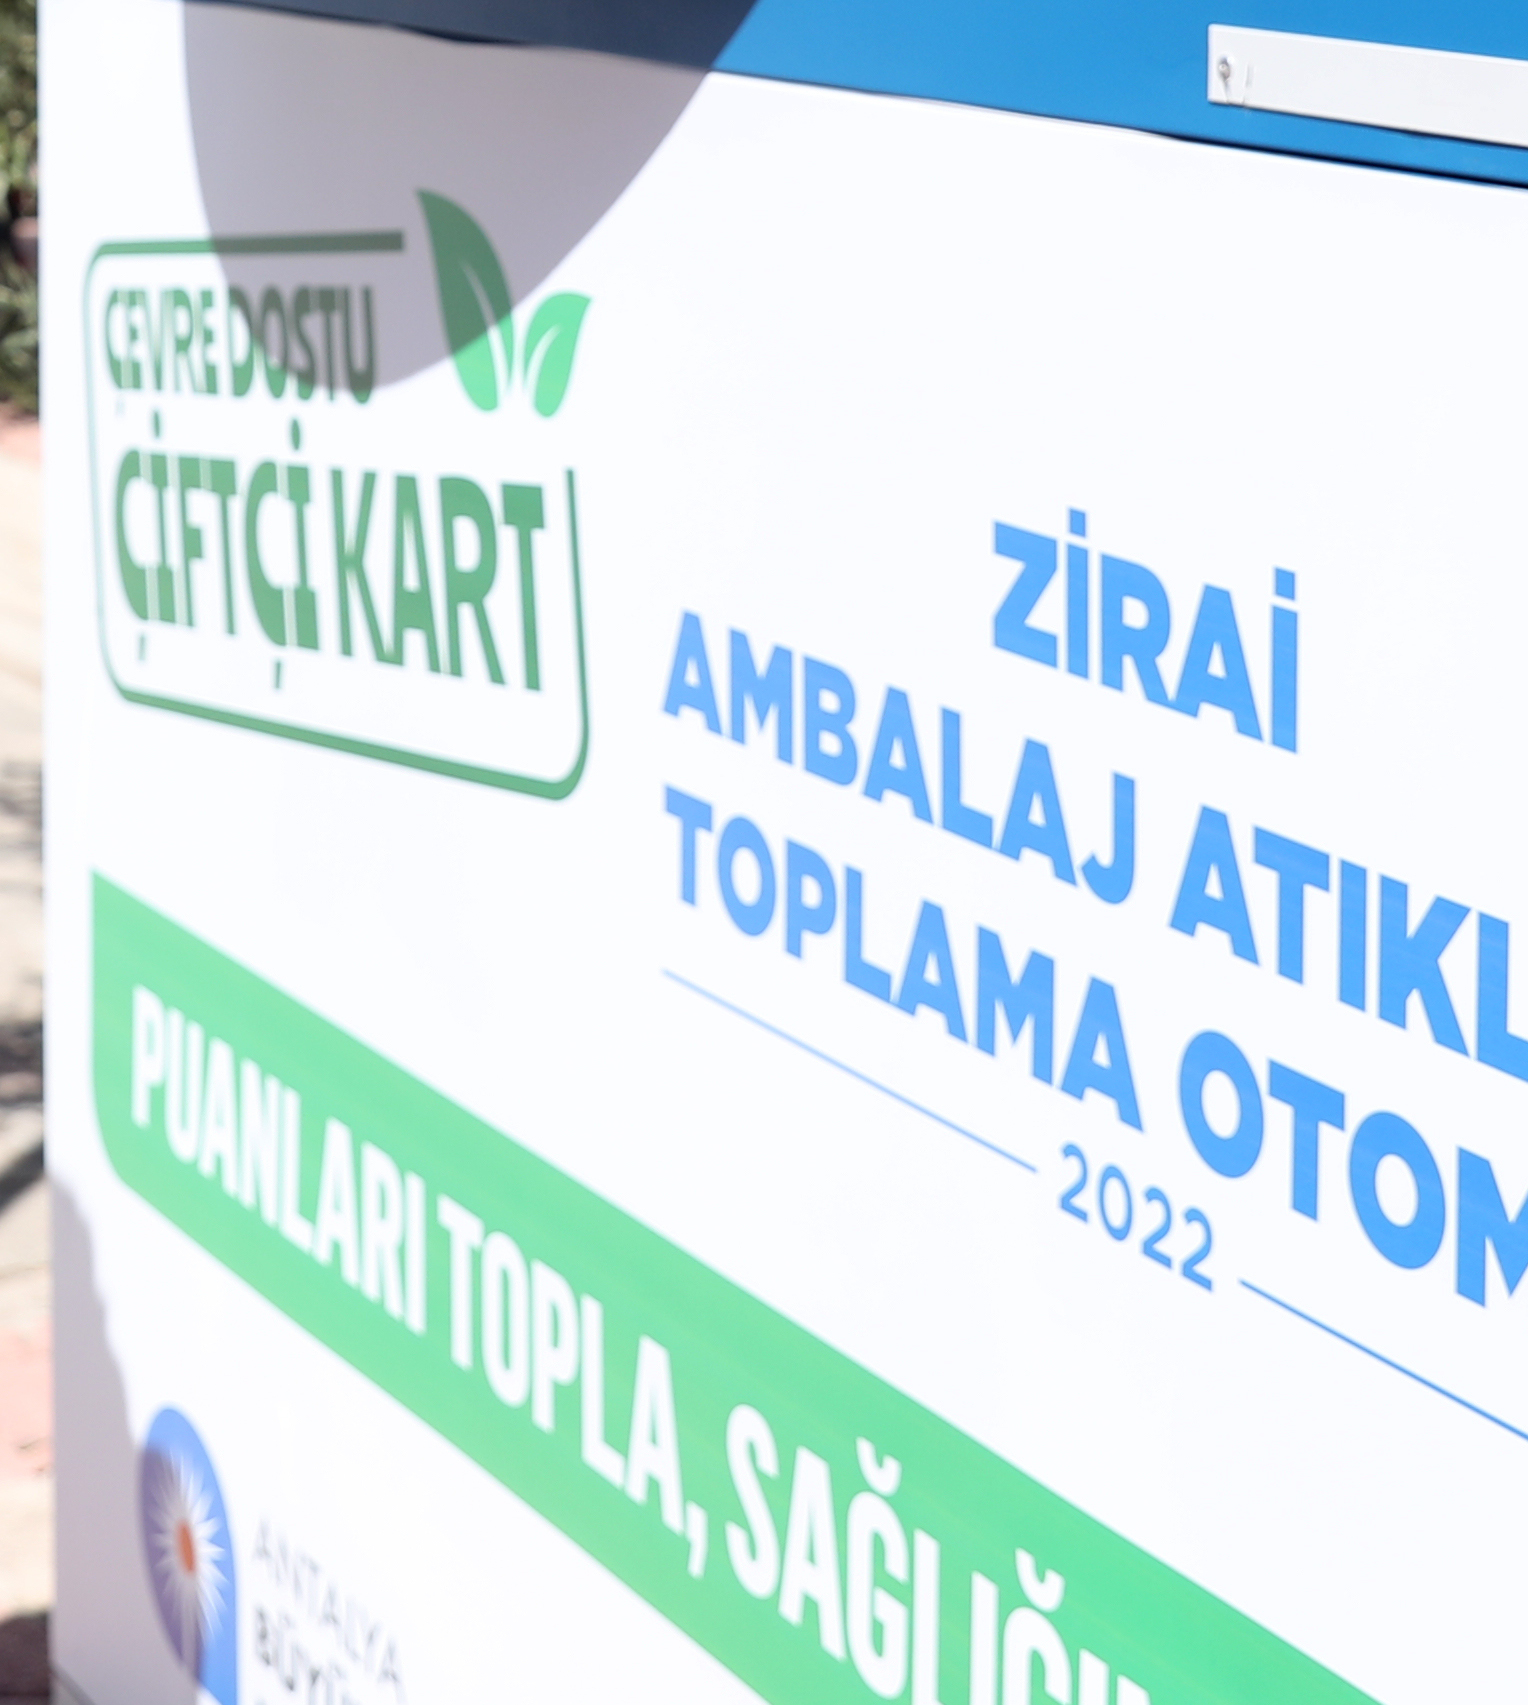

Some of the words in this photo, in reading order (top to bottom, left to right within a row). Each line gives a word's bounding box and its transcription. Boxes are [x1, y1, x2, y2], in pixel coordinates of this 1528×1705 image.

[104, 287, 220, 416] ÇEVRE
[226, 284, 378, 406] DOSTU
[113, 409, 322, 691] ÇİFTÇİ
[330, 466, 547, 694] KART
[992, 506, 1300, 755] ZİRAİ
[662, 608, 1137, 906] AMBALAJ
[664, 784, 1146, 1134] TOPLAMA
[132, 986, 426, 1334] PUANLARI
[438, 1196, 708, 1577] TOPLA,
[726, 1438, 1152, 1705] SAĞLIĞ
[1058, 1142, 1215, 1294] 2022
